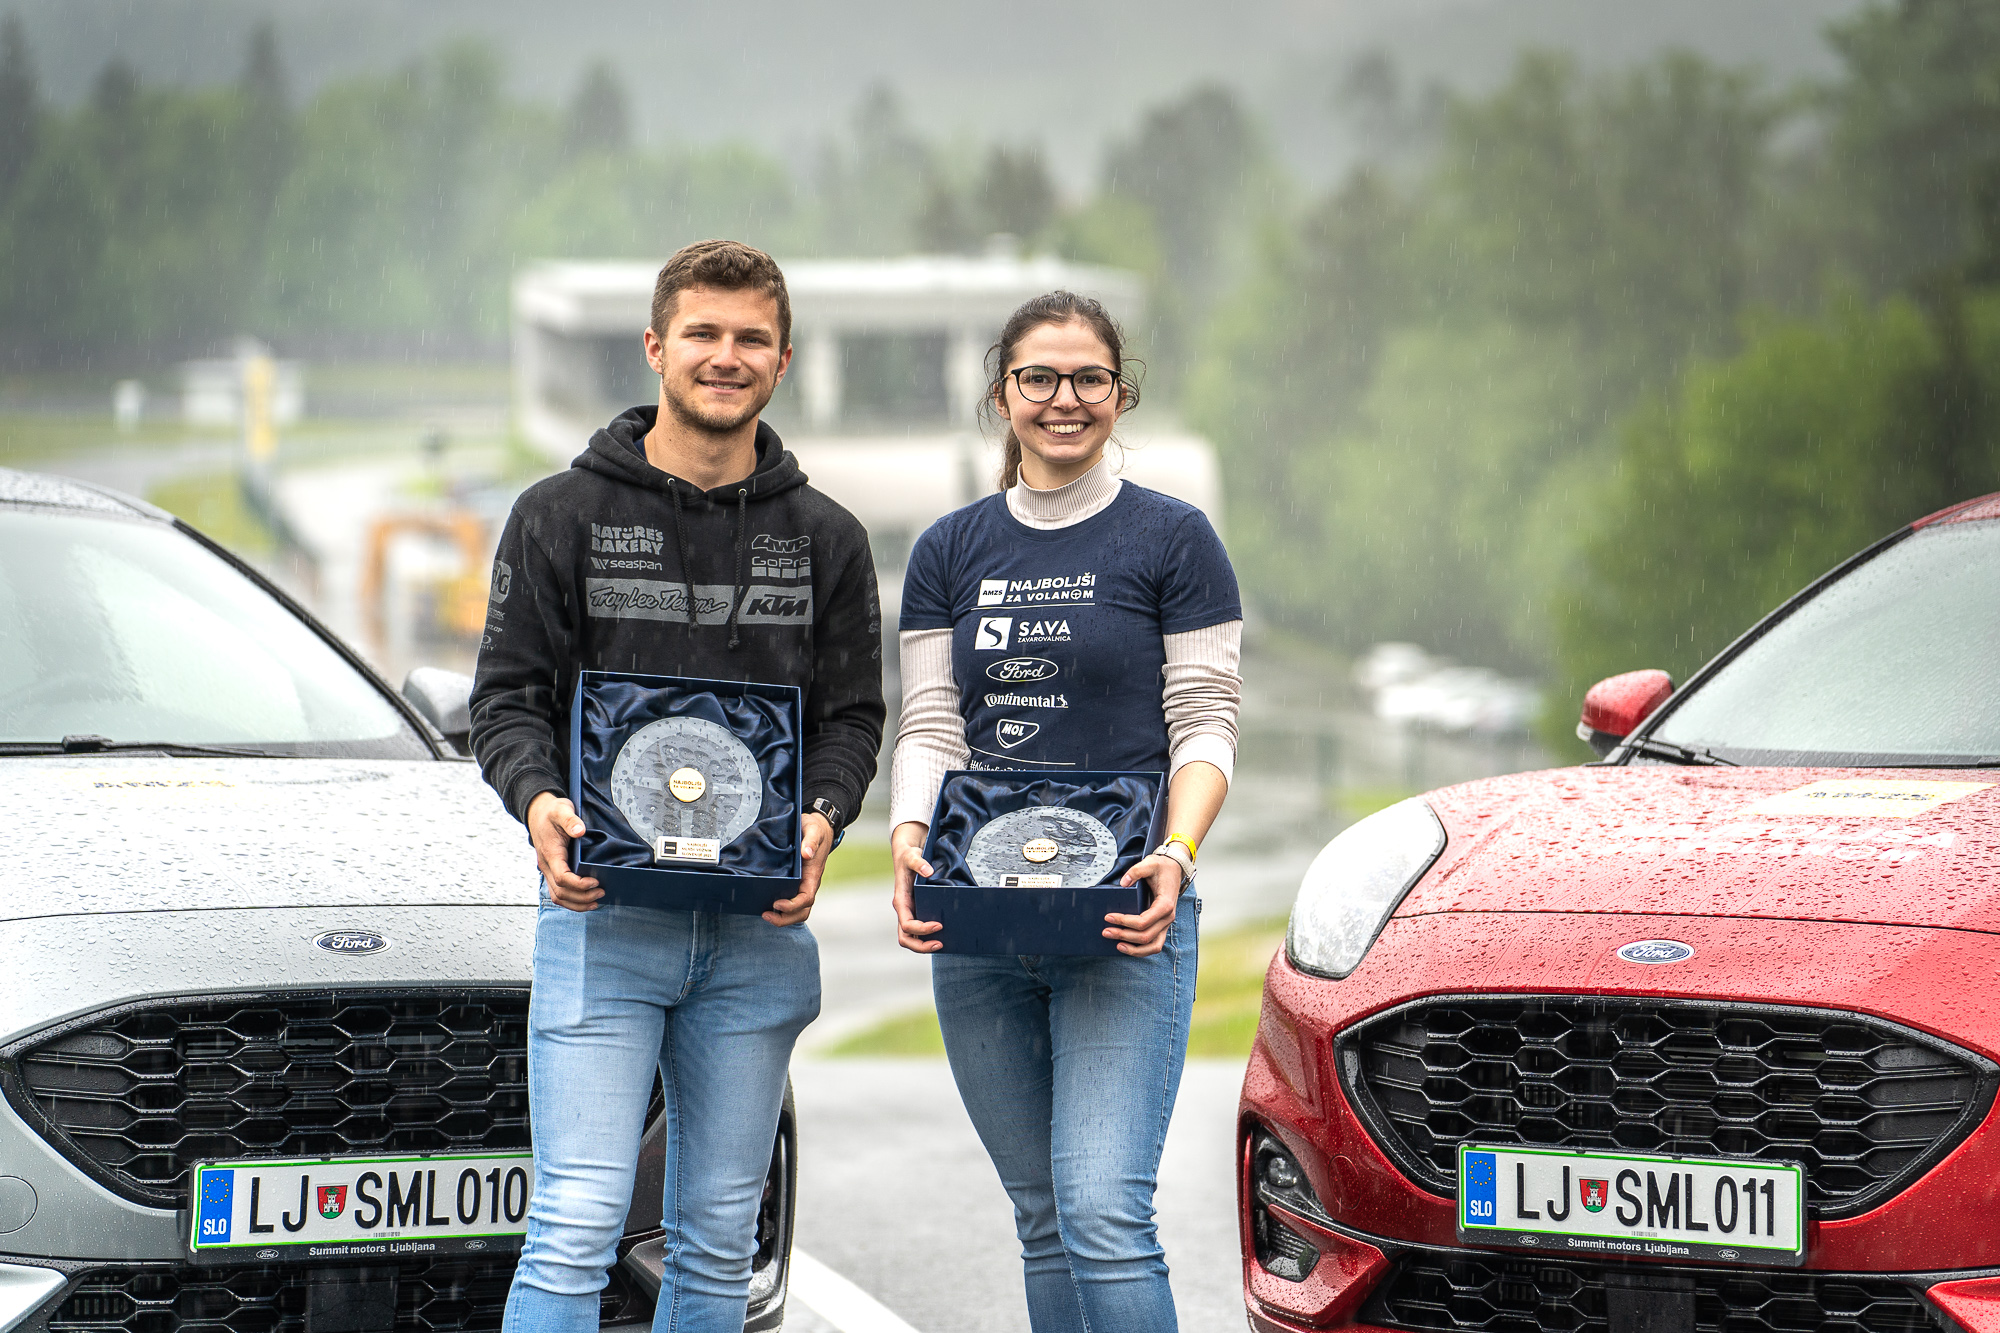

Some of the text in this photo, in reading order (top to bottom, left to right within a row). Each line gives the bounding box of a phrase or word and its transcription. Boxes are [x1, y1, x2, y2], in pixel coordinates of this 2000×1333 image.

[591, 536, 664, 555] BAKERY
[610, 560, 662, 571] seaspan
[752, 556, 810, 567] GoPro
[1010, 572, 1096, 592] NAJBOLJŠI
[590, 586, 627, 612] Troy
[627, 587, 659, 609] Lee
[1005, 589, 1094, 603] ZA VOLANOM
[746, 594, 809, 617] KTM
[1018, 620, 1072, 637] SAVA
[1000, 661, 1045, 679] Ford
[984, 692, 1056, 708] Continental
[1001, 723, 1025, 736] MOL
[331, 934, 374, 949] Ford
[1632, 944, 1678, 959] Ford
[249, 1166, 527, 1234] LJ SML010
[1470, 1200, 1492, 1217] SLO
[1516, 1163, 1775, 1237] LJ SML011
[203, 1217, 227, 1236] SLO
[309, 1242, 436, 1256] Summit motors Ljubljana
[1567, 1237, 1690, 1255] Summit motors Ljubljana
